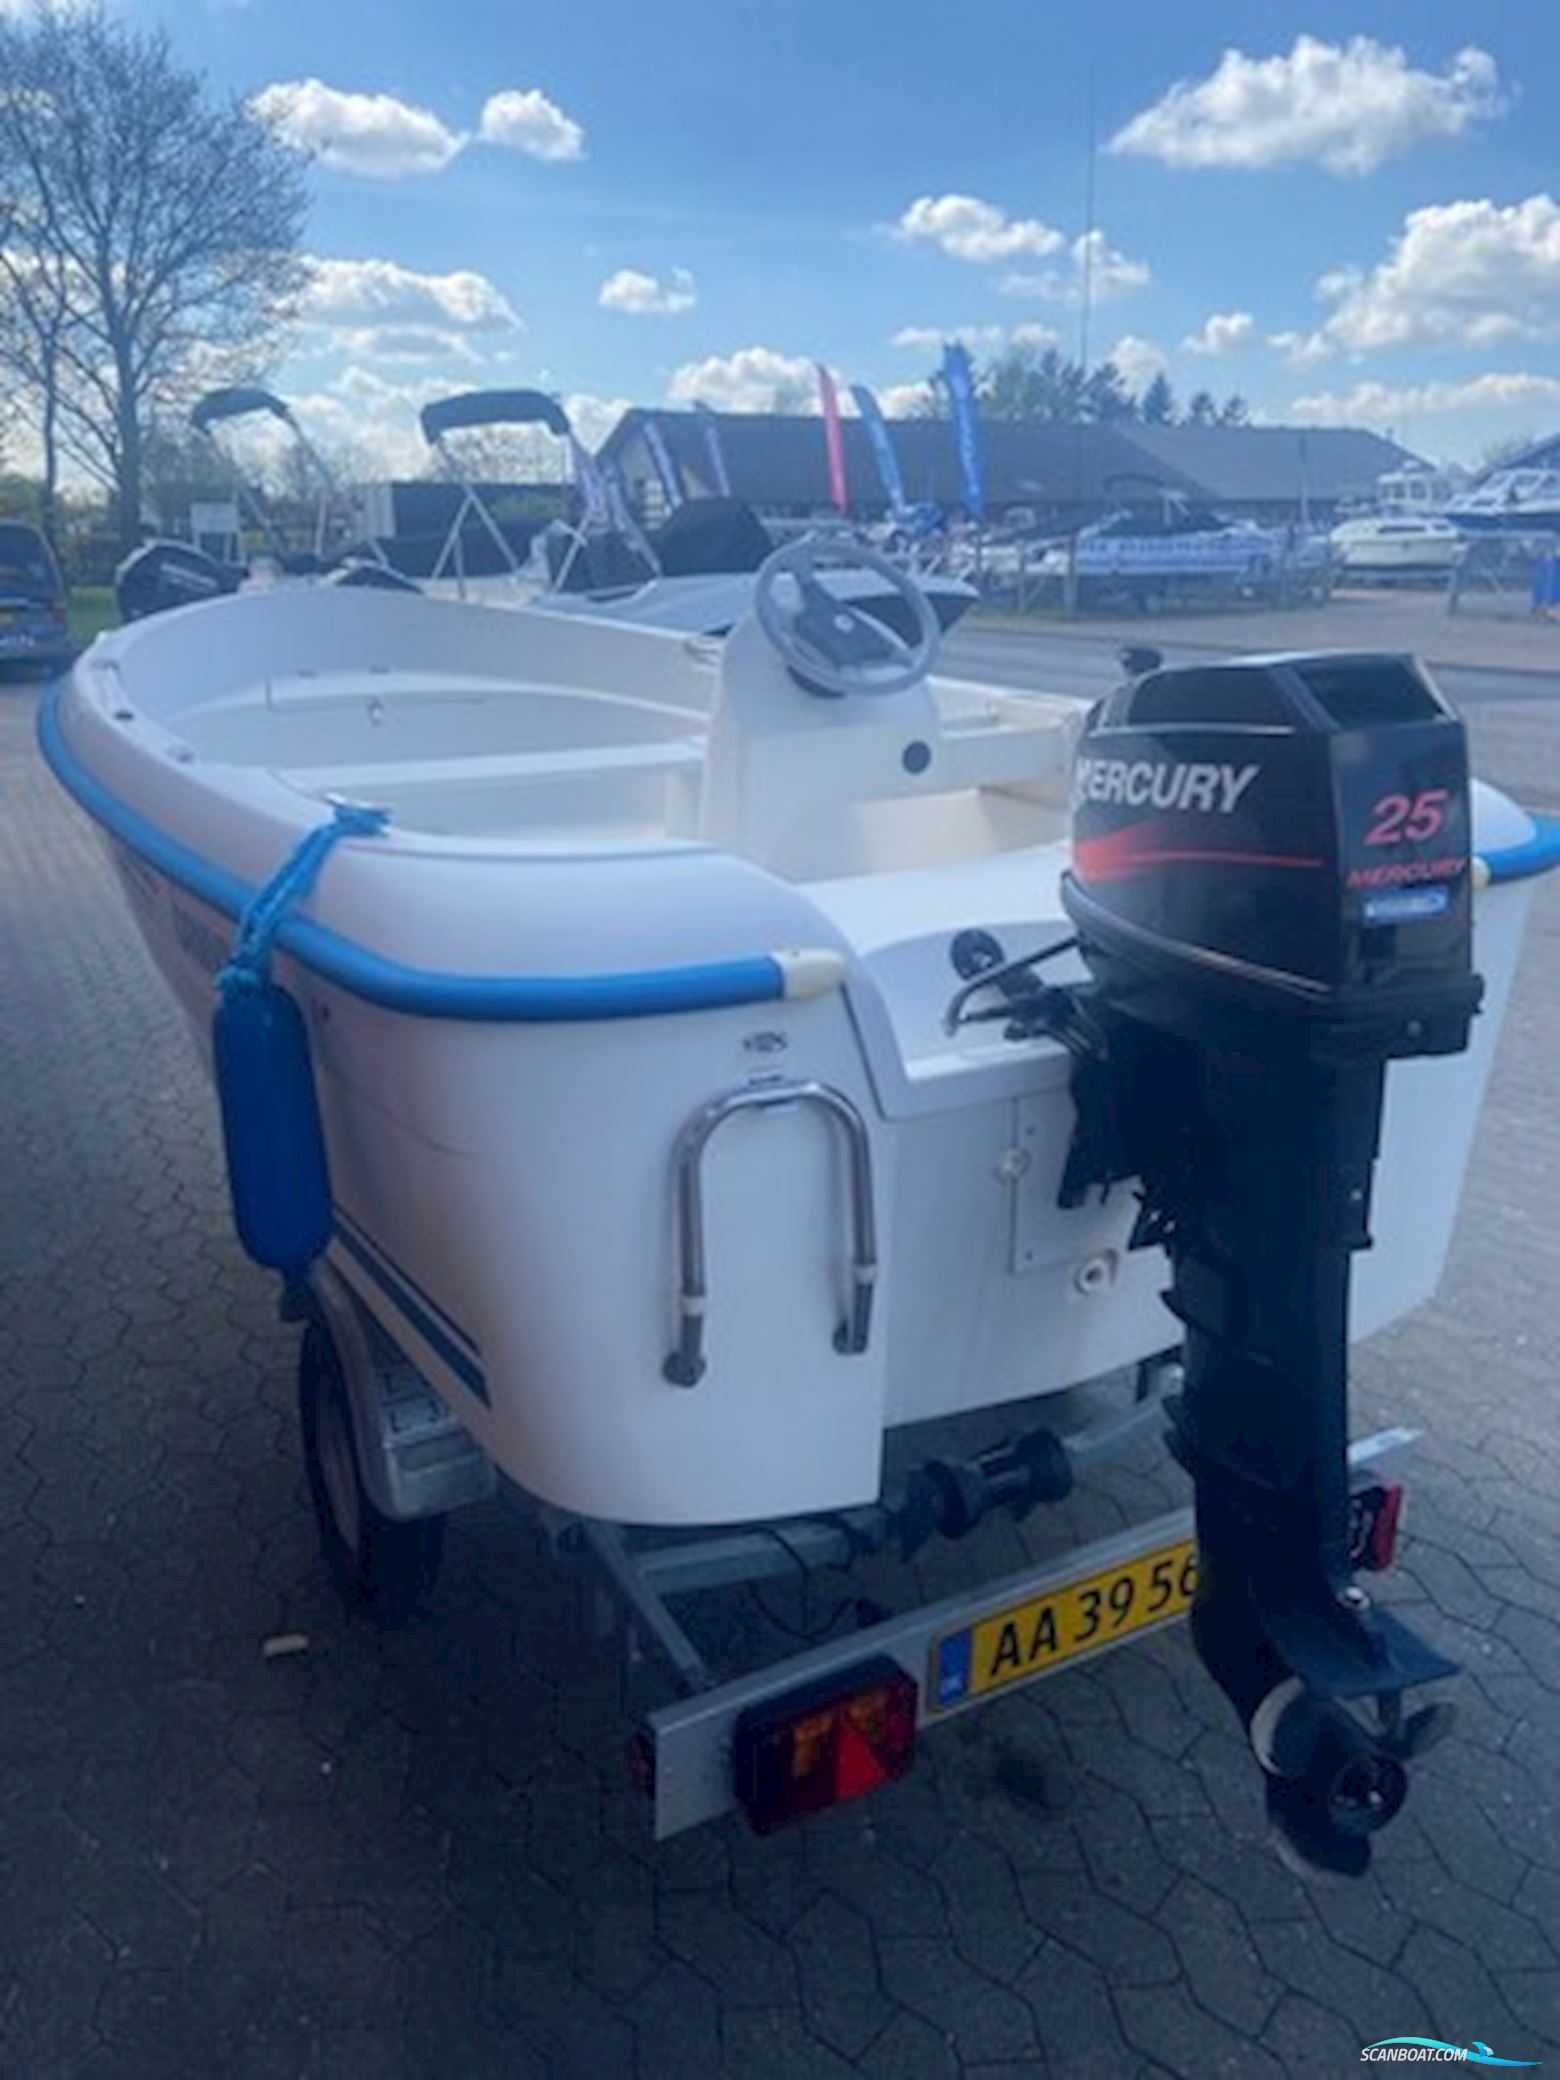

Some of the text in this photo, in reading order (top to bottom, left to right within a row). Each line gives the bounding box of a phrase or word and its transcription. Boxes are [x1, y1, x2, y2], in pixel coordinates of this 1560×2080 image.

[1363, 789, 1449, 847] 25
[1346, 857, 1468, 889] MERCURY
[990, 1607, 1059, 1677] AA
